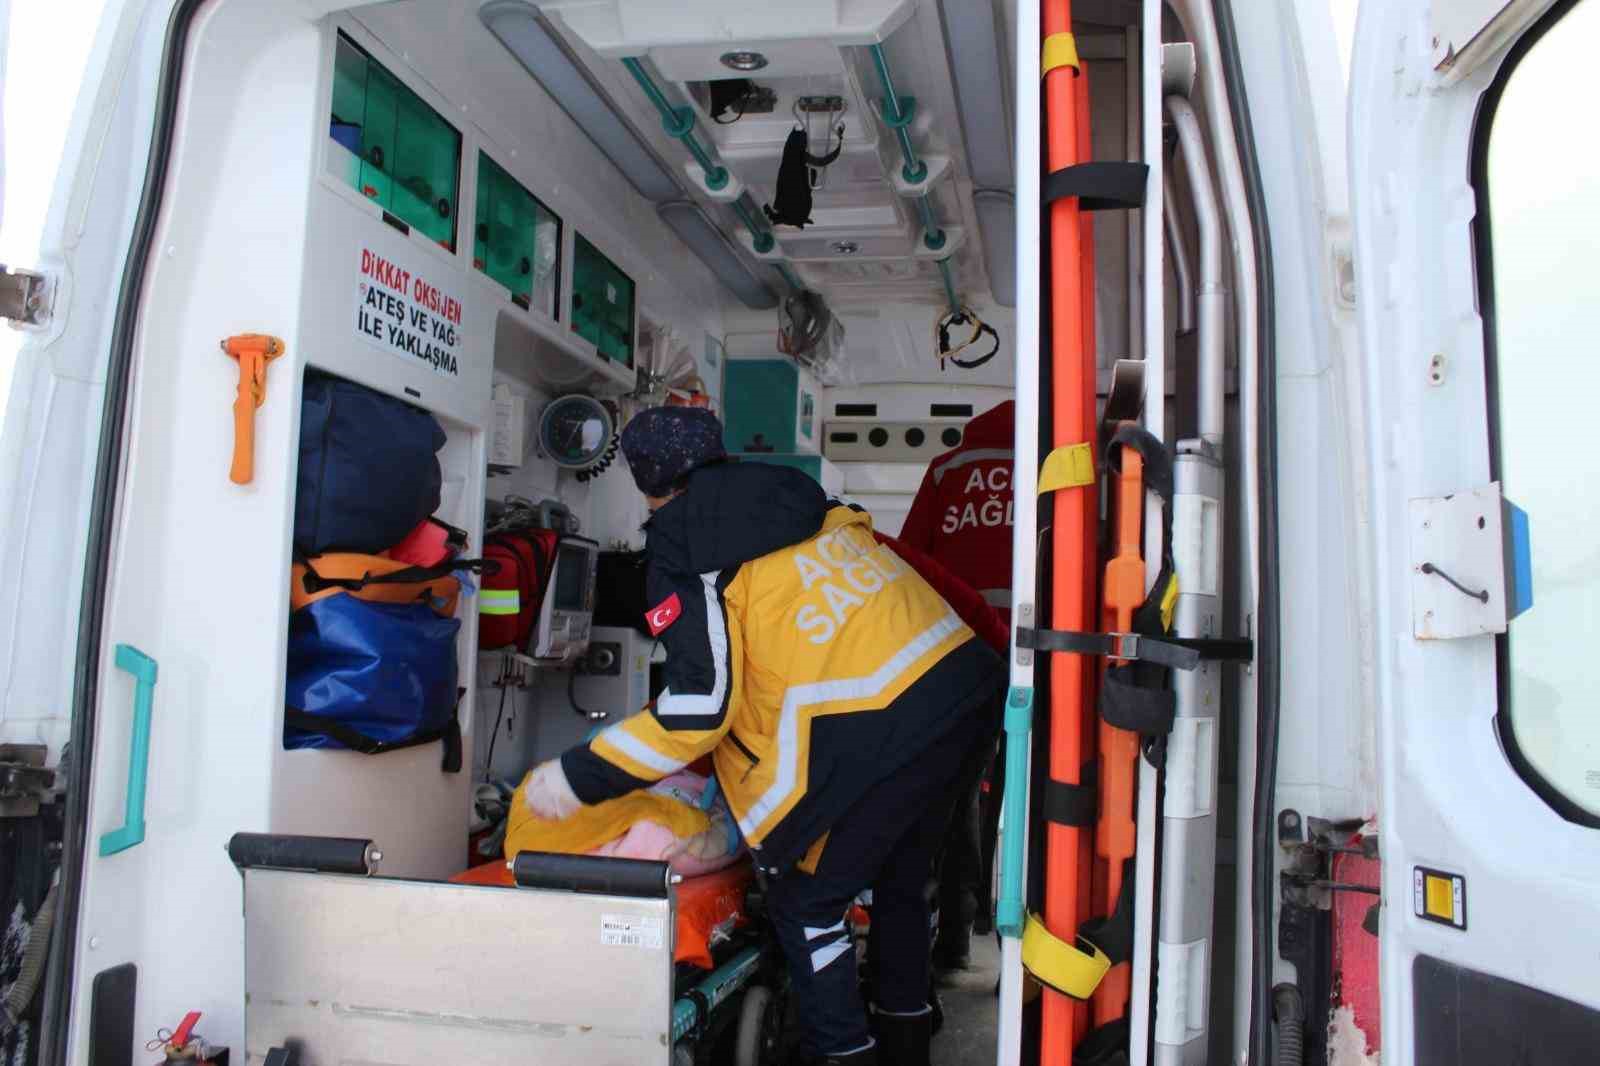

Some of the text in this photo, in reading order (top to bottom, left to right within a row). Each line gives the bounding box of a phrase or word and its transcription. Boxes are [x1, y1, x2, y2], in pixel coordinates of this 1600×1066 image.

[358, 305, 458, 376] İLE YAKLAŞMA
[366, 286, 455, 346] ATEŞ VE YAĞ
